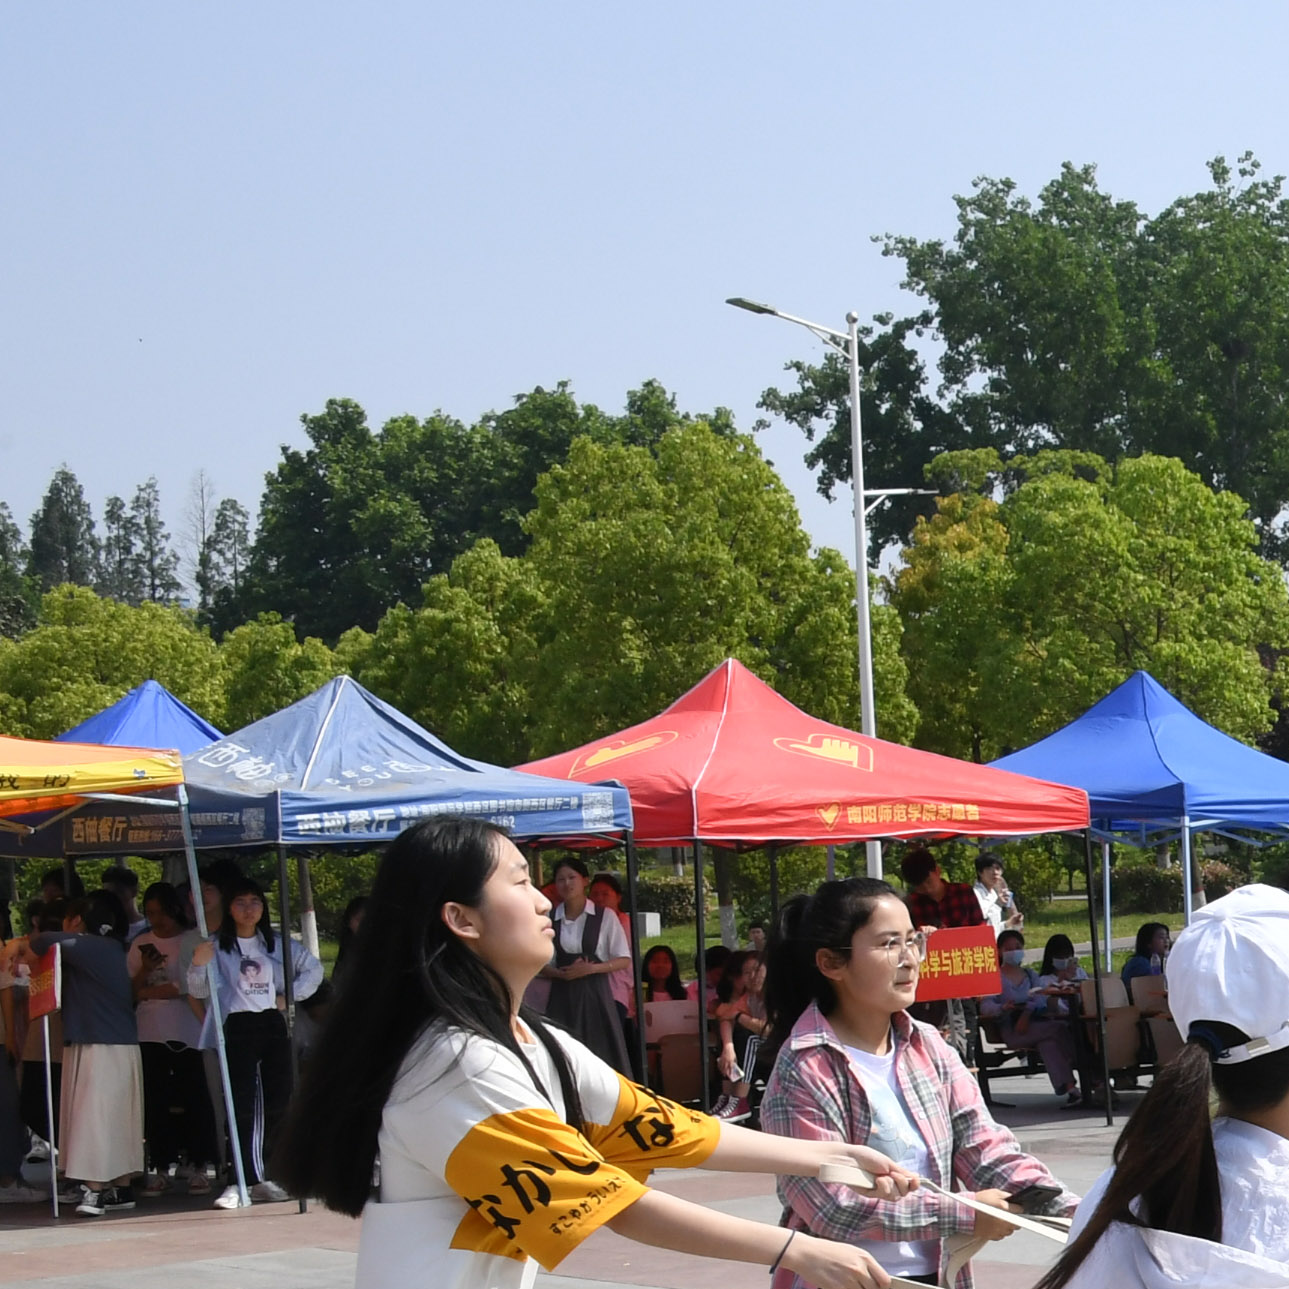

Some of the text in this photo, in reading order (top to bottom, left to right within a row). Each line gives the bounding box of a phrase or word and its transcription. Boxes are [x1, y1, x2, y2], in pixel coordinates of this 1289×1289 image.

[295, 808, 397, 836] 西柚餐厅
[847, 803, 980, 824] 南阳师范学院志愿者
